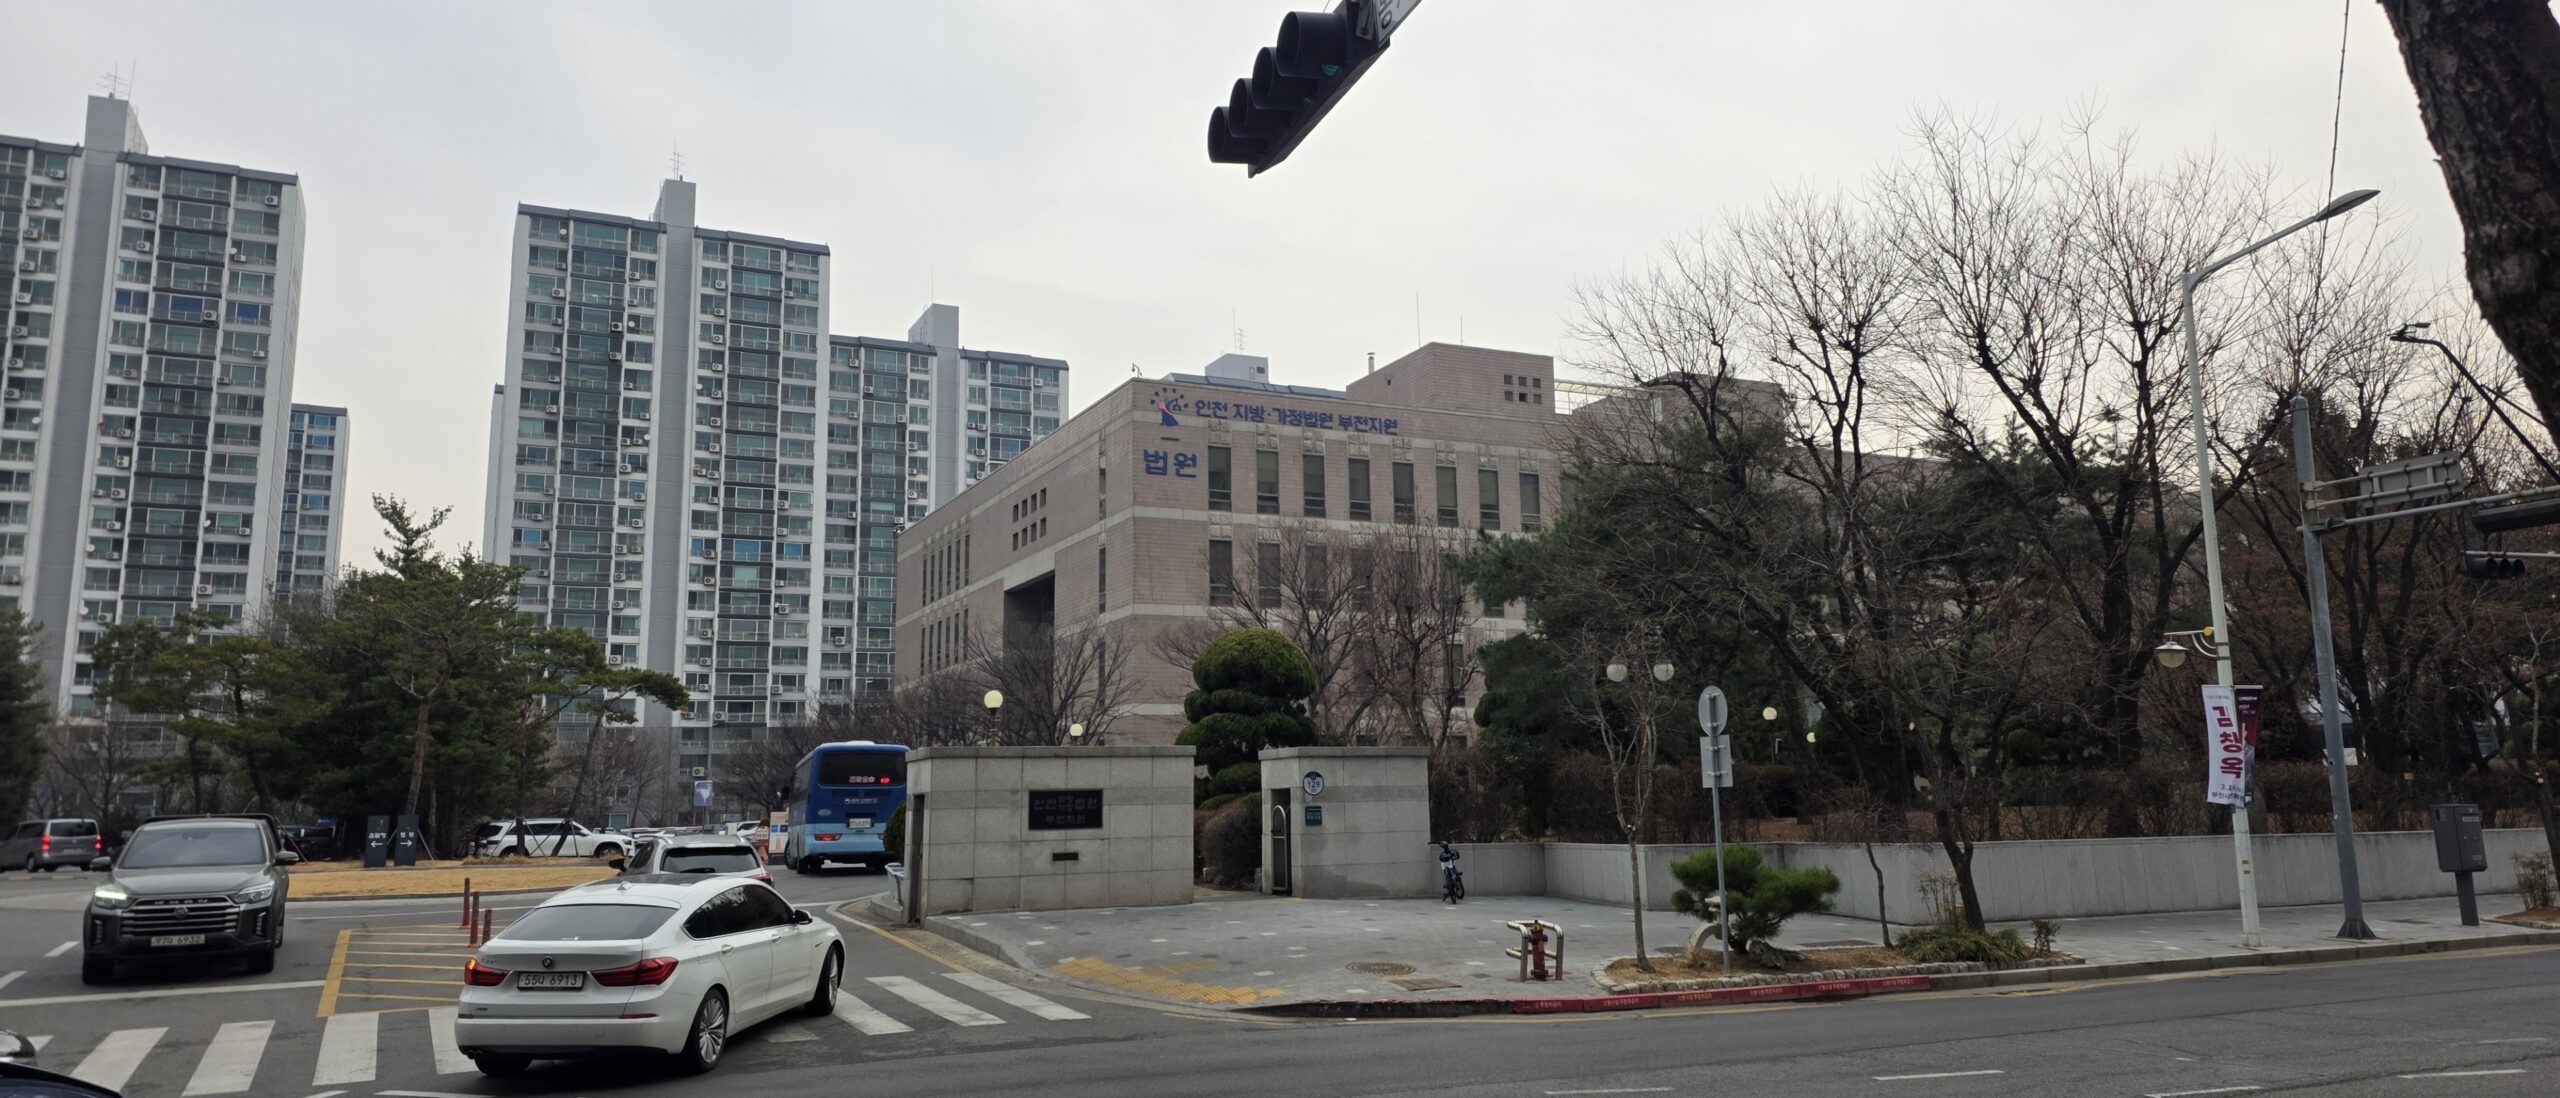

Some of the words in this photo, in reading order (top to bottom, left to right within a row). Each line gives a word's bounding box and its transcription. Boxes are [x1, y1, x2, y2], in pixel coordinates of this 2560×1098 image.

[1194, 399, 1228, 420] 인천
[1338, 414, 1398, 435] 부천지원
[1143, 448, 1198, 478] 법원
[1307, 780, 1321, 788] 129
[549, 974, 578, 986] 6913
